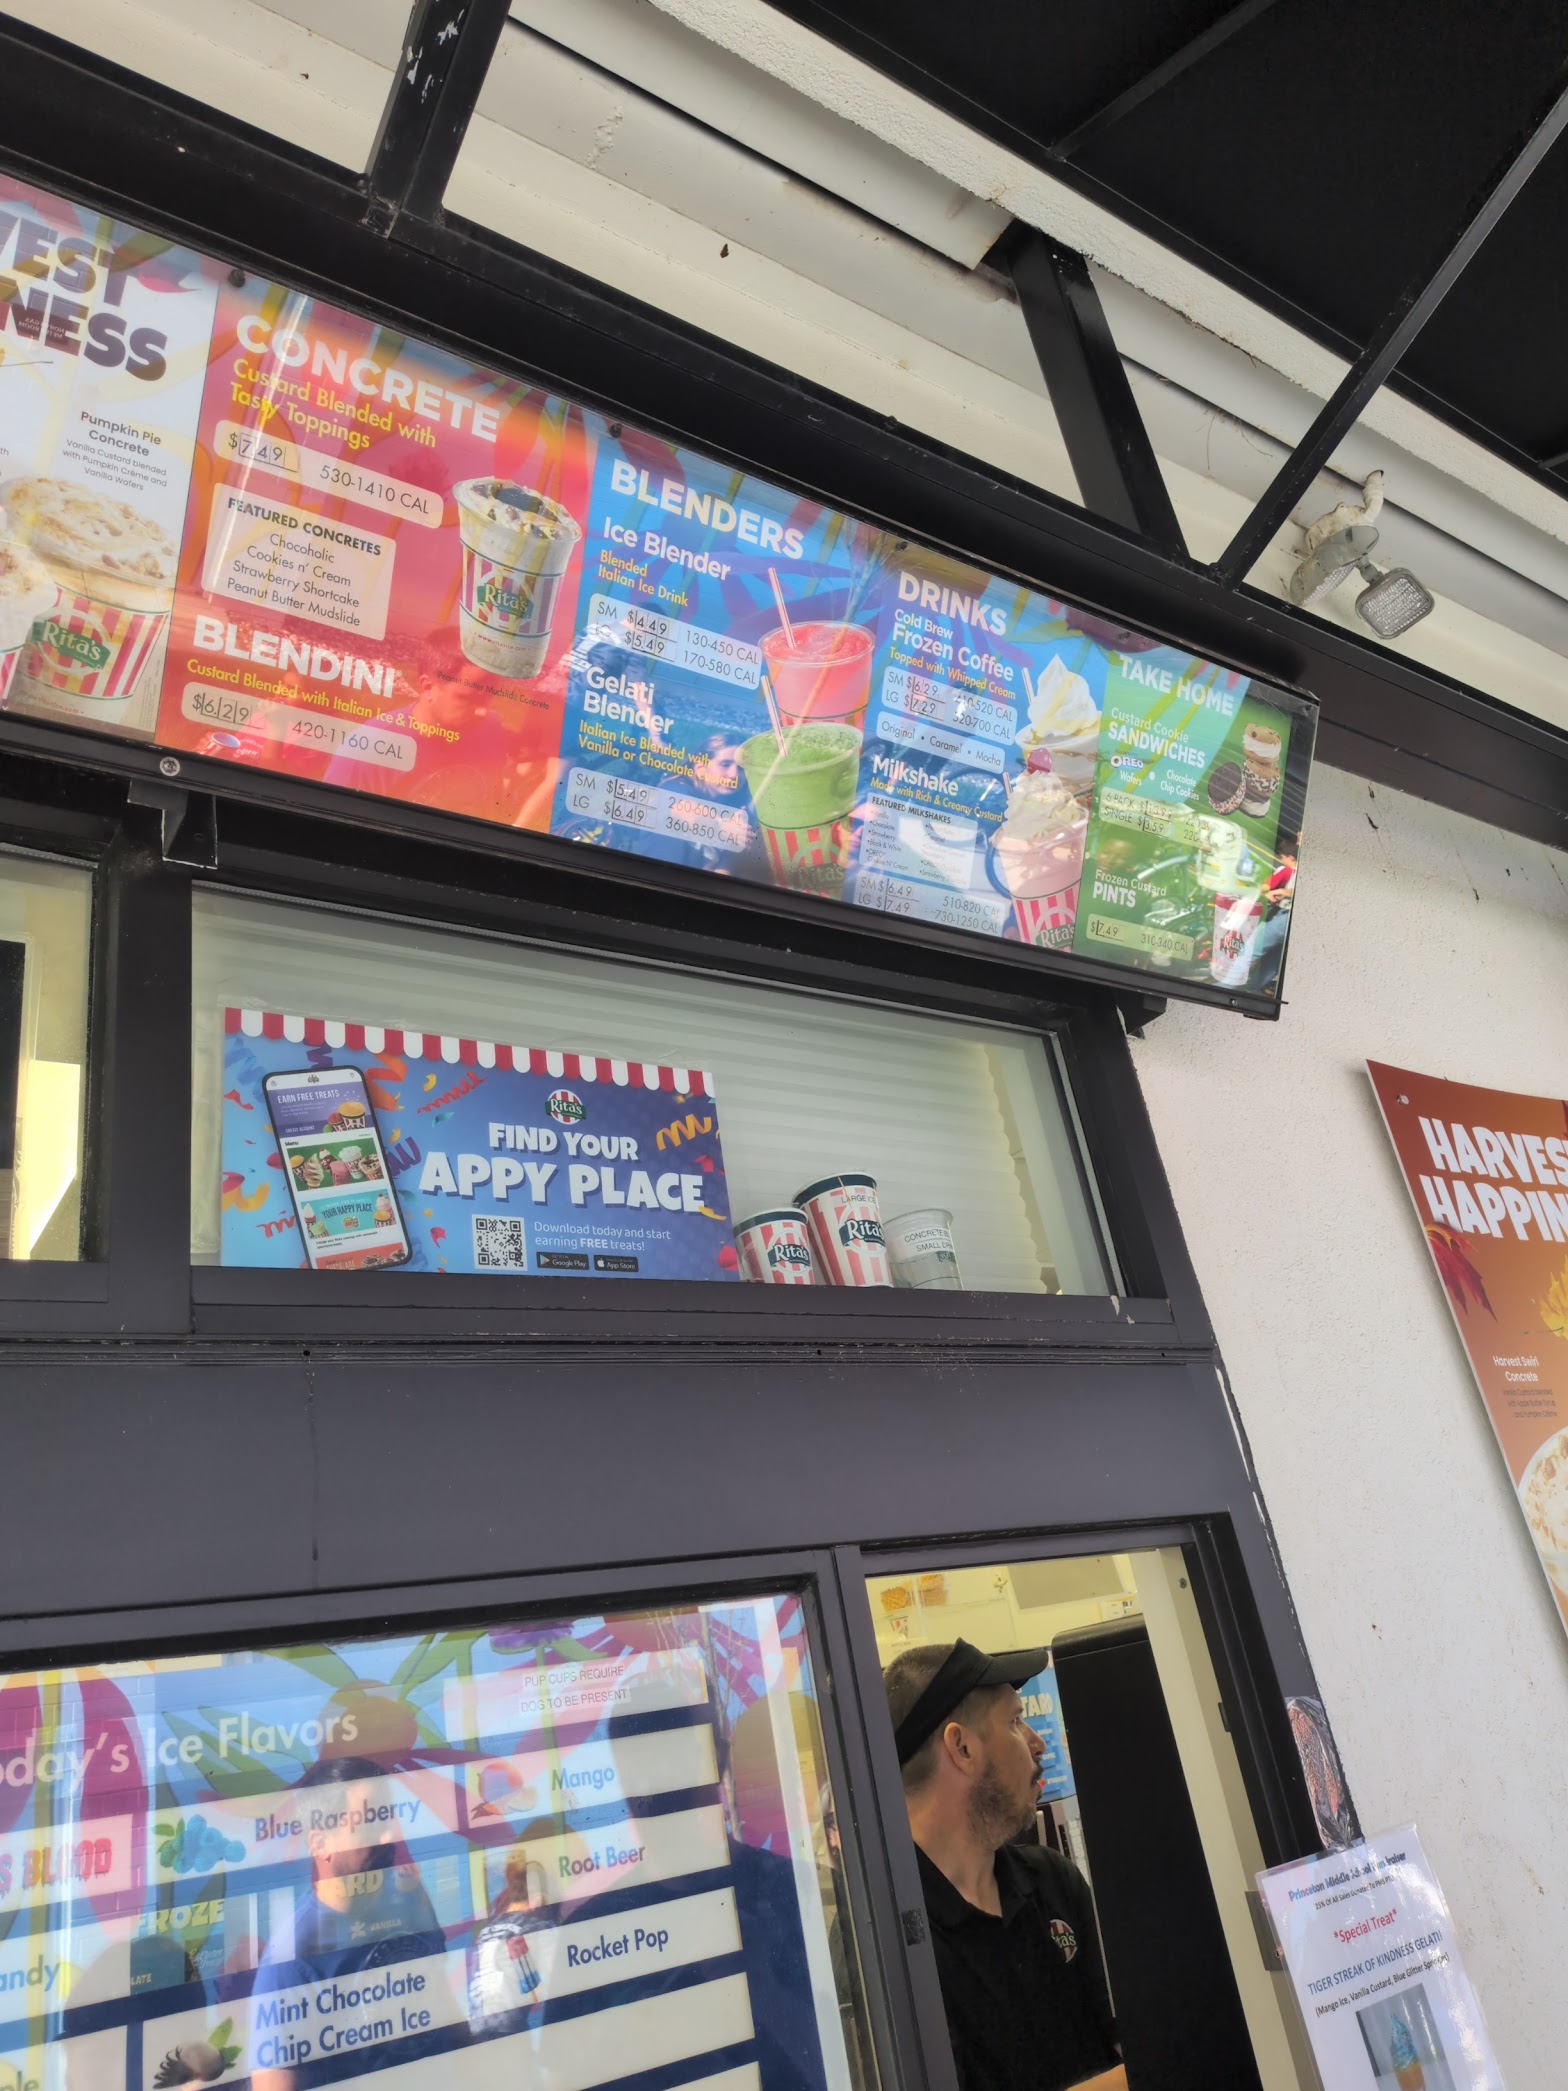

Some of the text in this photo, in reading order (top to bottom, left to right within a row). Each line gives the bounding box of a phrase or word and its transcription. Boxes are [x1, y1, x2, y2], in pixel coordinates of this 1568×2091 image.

[237, 315, 500, 442] CONCRETE
[230, 382, 370, 450] Tasty Toppings
[233, 359, 436, 448] Custard Blended with
[80, 411, 162, 446] Pumpkin Pie
[88, 430, 150, 456] Concrete
[320, 465, 395, 503] 530-1410
[400, 493, 430, 515] CAL
[611, 458, 805, 560] BLENDERS
[228, 497, 382, 556] FEATURED CONCRETES
[247, 546, 294, 570] Cookies
[313, 566, 351, 587] Cream
[270, 534, 335, 564] Chocoholic
[600, 550, 648, 577] Blended
[604, 517, 731, 581] Ice Blender
[228, 578, 360, 626] Peanut Butter Mudslide
[233, 560, 360, 608] Strawberry Shortcake
[486, 583, 528, 613] Rita's
[598, 565, 689, 607] Italian Ice Drink
[898, 571, 1008, 636] DRINKS
[43, 619, 102, 661] Rita's
[894, 608, 954, 640] Cold Brew
[893, 622, 1014, 681] Frozen Coffee
[586, 666, 655, 706] Gelati
[890, 647, 1016, 700] Topped with Whipped Cream
[1119, 654, 1234, 716] TAKE HOME
[187, 658, 460, 742] Custard Blended with Italian Ice & Toppings
[583, 690, 674, 734] Blender
[292, 720, 370, 751] 420-1160
[374, 740, 404, 760] CAL
[579, 720, 712, 767] Italian Ice Blended with
[882, 721, 1001, 766] Original Caramel Mocha
[1108, 721, 1206, 768] SANDWICHES
[1111, 707, 1189, 744] Custard Cookie
[578, 734, 620, 758] Vanilla
[623, 751, 636, 762] or
[639, 751, 694, 777] Chocolate
[873, 755, 959, 796] Milkshake
[1110, 755, 1144, 769] OREO
[1120, 770, 1142, 786] Wafers
[1160, 780, 1200, 801] Chip Cookies
[1166, 770, 1197, 787] Chocolate
[576, 773, 596, 790] SM
[720, 810, 743, 826] CAL
[870, 777, 1003, 822] Made with Rich & Creamy Custard
[872, 796, 952, 824] FEATURED MILKSHAKES
[1092, 881, 1136, 908] PINTS
[1096, 868, 1167, 897] Frozen Custard
[1040, 924, 1075, 948] Rita's
[1224, 936, 1244, 952] Rita's
[278, 1090, 340, 1104] EARN FREE TREATS
[550, 1098, 582, 1114] Rita's
[489, 1122, 639, 1160] FIND YOUR
[1418, 1116, 1568, 1186] HARVES
[419, 1152, 705, 1212] APPY PLACE
[338, 1204, 356, 1216] HAPPY
[356, 1203, 372, 1213] PLACE
[846, 1218, 884, 1240] Rita's
[534, 1222, 672, 1240] Download today and start
[535, 1236, 646, 1251] earning FREE treats!
[904, 1228, 943, 1242] CONCRETE
[552, 1258, 636, 1270] Google Play App Store
[775, 1242, 809, 1262] Rita's
[524, 1663, 625, 1688] PUP CUPS REQUIRE
[520, 1688, 628, 1714] DOG TO BE PRESENT
[147, 1728, 203, 1768] Ice
[219, 1710, 359, 1759] Flavors
[551, 1764, 616, 1793] Mango
[255, 1798, 421, 1842] Blue Raspberry
[558, 1844, 646, 1879] Root Beer
[1288, 1870, 1350, 1902] Princeton Middle
[566, 1926, 670, 1968] Rocket Pop
[1308, 1930, 1444, 1996] TIGER STREAK OF KINDNESS GELATI!
[255, 1970, 426, 2032] Mint Chocolate
[1315, 2001, 1340, 2018] (Mango
[1350, 1986, 1370, 2001] Vanilla
[1370, 1978, 1394, 1993] Custard,
[1392, 1972, 1406, 1983] Blue
[1406, 1963, 1424, 1978] Glitter
[256, 2007, 431, 2068] Chip Cream Ice
